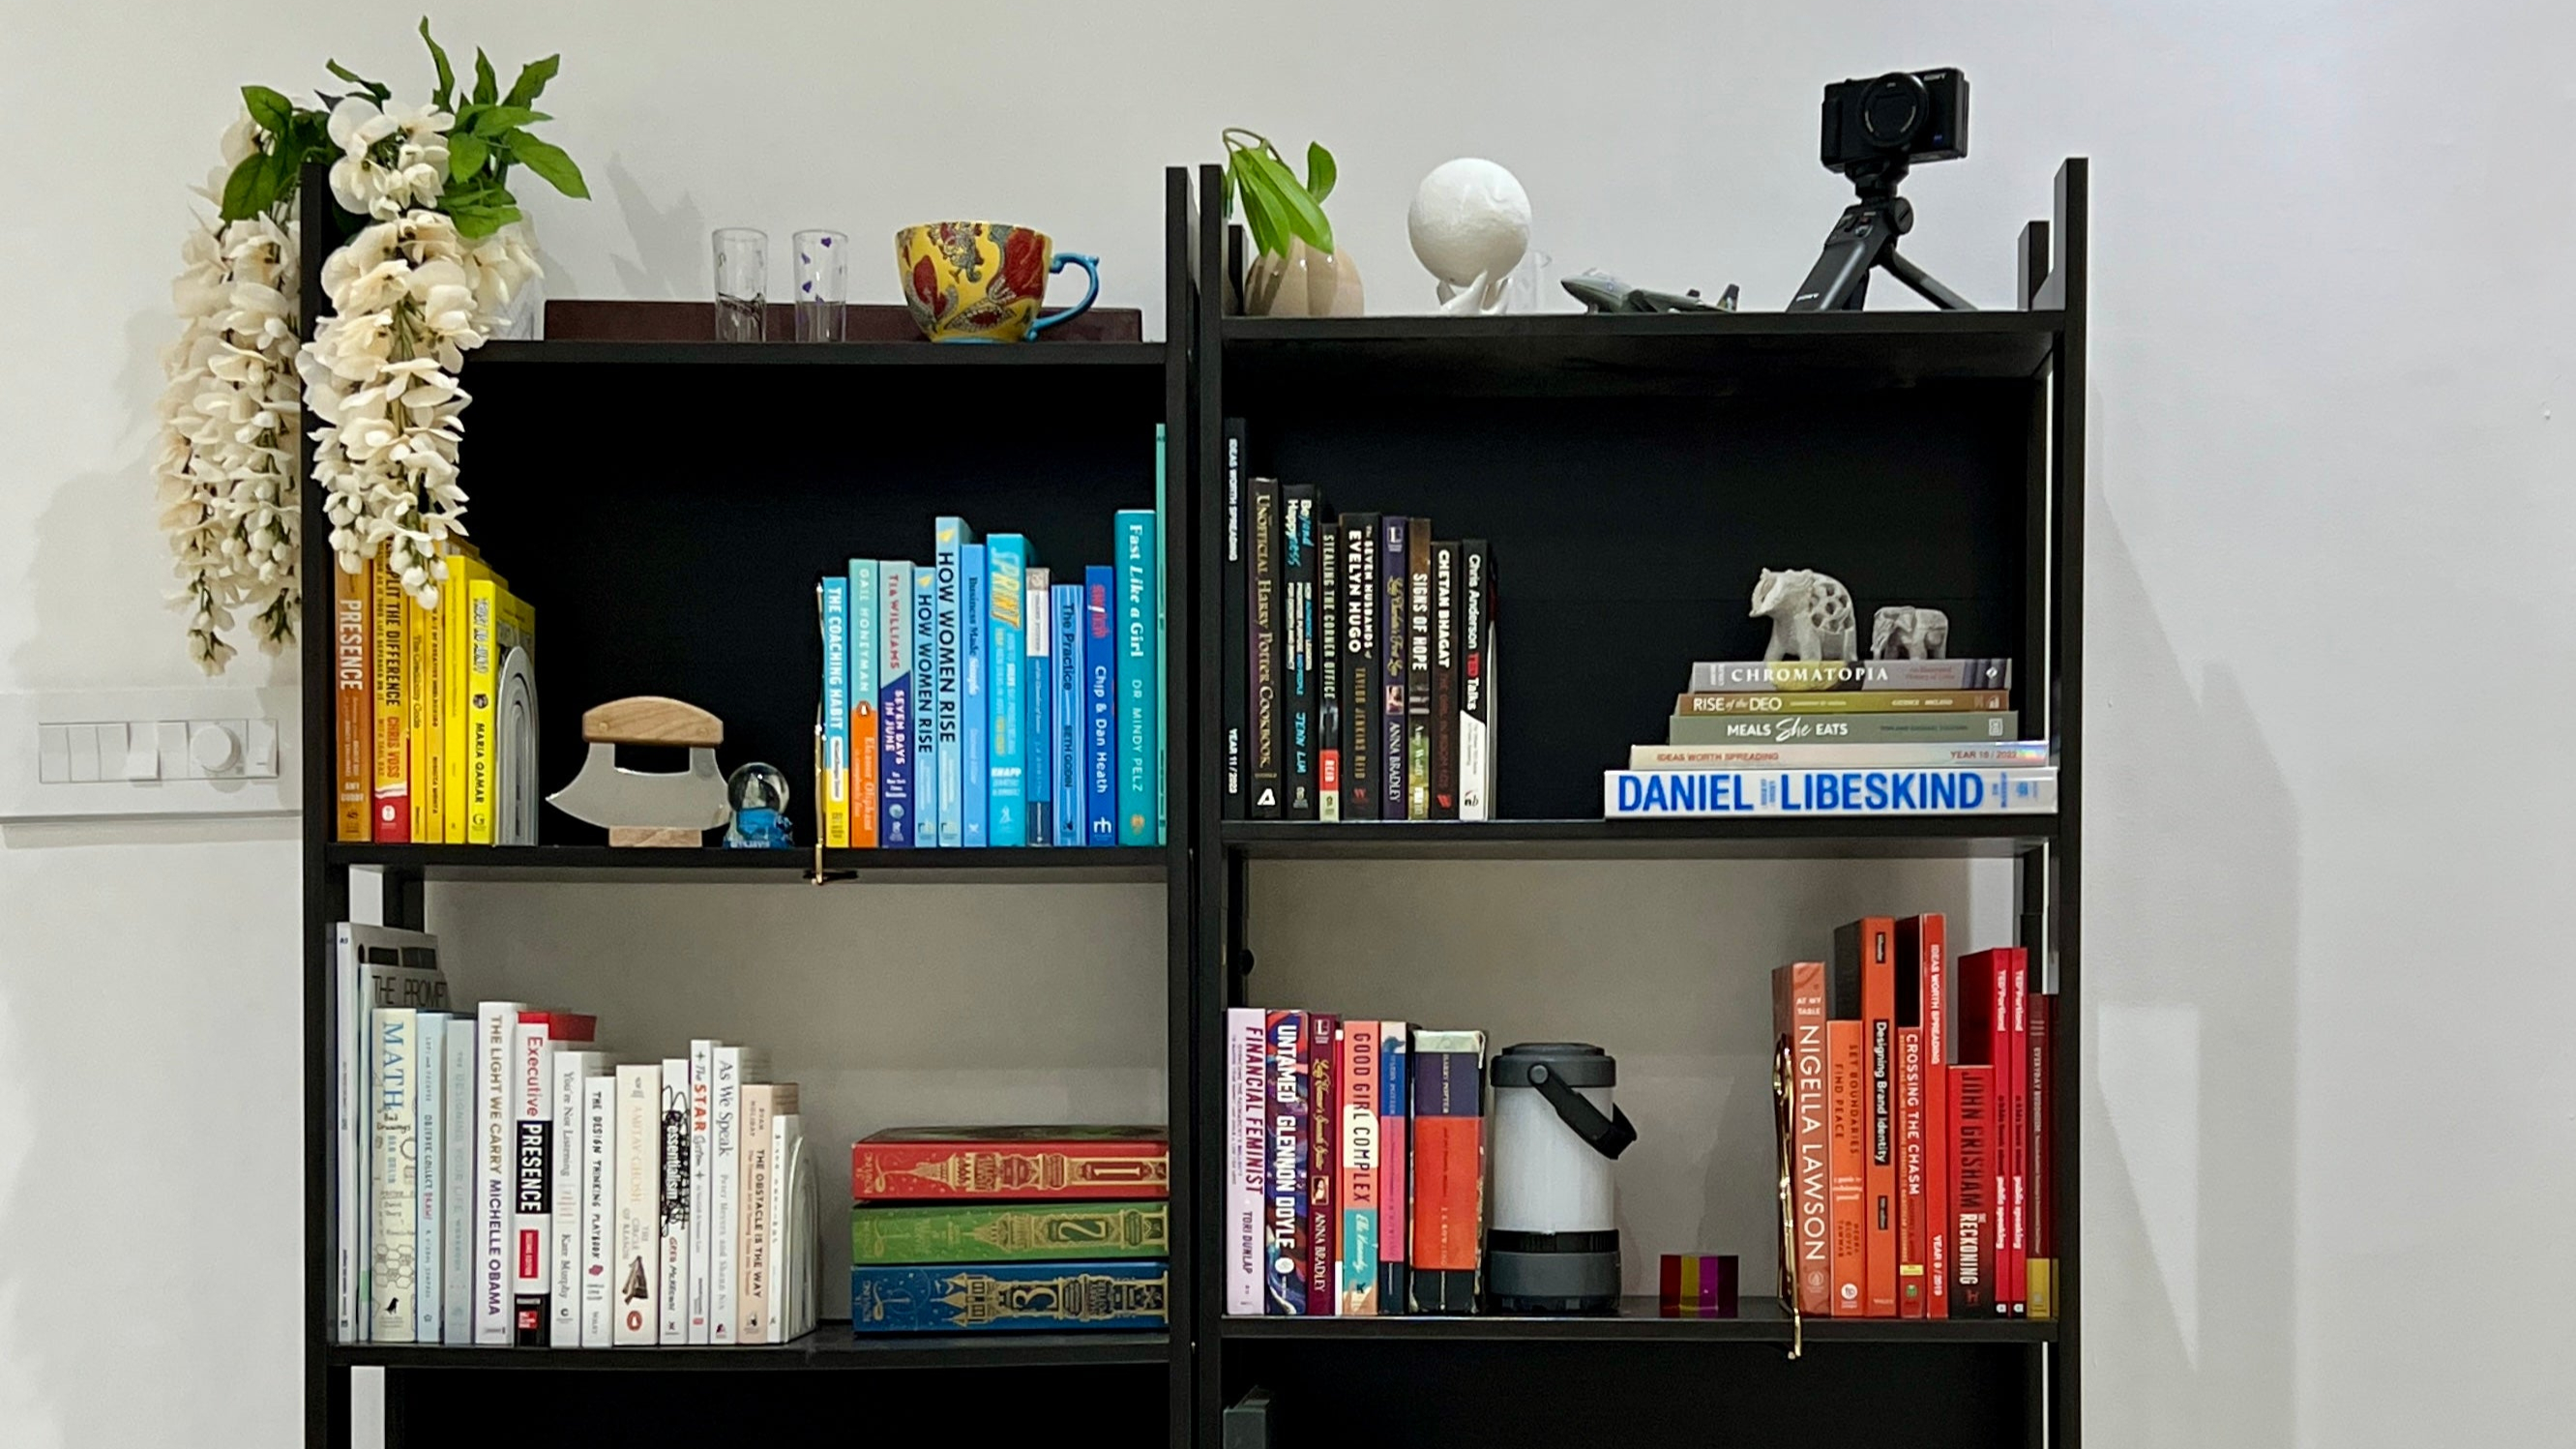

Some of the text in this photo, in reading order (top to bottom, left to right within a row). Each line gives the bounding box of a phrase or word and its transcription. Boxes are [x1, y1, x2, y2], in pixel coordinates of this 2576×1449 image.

[1229, 438, 1238, 561] IDEAS WORTH SPREADING
[938, 552, 955, 604] HOW
[991, 547, 1022, 630] SPRINT
[1130, 524, 1143, 657] Fast Like a Girl
[1349, 530, 1361, 653] EVELYN HUGO
[1364, 541, 1373, 579] SEVEN
[1467, 554, 1480, 587] Chris
[387, 604, 400, 626] THE
[829, 587, 843, 613] THE
[859, 568, 870, 692] GAIL HONEYMAN
[889, 575, 900, 669] TIA WILLIAMS
[918, 594, 933, 636] HOW
[1323, 534, 1335, 698] STEALING THE CORNER OFFICE
[1364, 584, 1373, 648] HUSBANDS
[1412, 573, 1427, 670] SIGNS OF HOPE
[1438, 550, 1450, 667] CHETAN BHAGAT
[1467, 590, 1480, 649] Anderson
[340, 600, 363, 690] PRESENCE
[387, 631, 400, 706] DIFFERENCE
[413, 636, 422, 651] The
[829, 616, 843, 685] COACHING
[918, 643, 933, 714] WOMEN
[938, 611, 955, 693] WOMEN
[1063, 603, 1074, 691] The Practice
[1732, 667, 1888, 682] CHROMATOPIA
[413, 703, 422, 727] Code
[831, 689, 843, 729] HABIT
[885, 702, 894, 752] IN JUNE
[895, 690, 905, 729] SEVEN
[938, 701, 955, 742] RISE
[1094, 665, 1108, 792] Chip & Dan Heath
[1132, 707, 1142, 752] MINDY
[1467, 678, 1479, 710] Talks
[1694, 697, 1725, 711] RISE
[1749, 697, 1782, 711] DEO
[1728, 717, 1849, 742] MEALS She EATS
[387, 717, 400, 778] CHRIS VOSS
[475, 723, 485, 803] MARIA QAMAR
[895, 733, 905, 765] DAYS
[918, 719, 933, 753] RISE
[1389, 722, 1400, 802] ANNA BRADLEY
[1688, 753, 1722, 761] WORTH
[863, 737, 874, 831] Eleanor Oliphant
[1132, 757, 1142, 792] PELZ
[1618, 775, 1754, 811] DANIEL
[1781, 772, 1984, 811] LIBESKIND
[1931, 944, 1939, 1064] IDEAS WORTH SPREADING
[383, 1021, 404, 1109] MATH
[527, 1036, 543, 1116] Executive
[695, 1065, 706, 1080] The
[1849, 1045, 1859, 1066] SET
[1875, 1021, 1888, 1162] Designing Brand Identity
[1907, 1034, 1919, 1107] CROSSING
[490, 1015, 502, 1174] THE LIGHT WE CARRY
[561, 1071, 575, 1175] You're Not Listening
[695, 1084, 706, 1132] STAR
[716, 1061, 733, 1156] As We Speak
[1246, 1027, 1263, 1195] FINANCIAL FEMINIST
[1353, 1032, 1371, 1202] GOOD GIRL COMPLEX
[1835, 1064, 1844, 1138] FIND PEACE
[1907, 1111, 1919, 1138] THE
[521, 1123, 542, 1211] PRESENCE
[667, 1125, 681, 1199] essentialism
[1094, 1168, 1140, 1176] 1
[1276, 1025, 1297, 1249] UNTAMED GLENNON DOYLE
[1799, 1025, 1825, 1259] NIGELLA LAWSON
[1907, 1144, 1919, 1195] CHASM
[1961, 1072, 1984, 1207] JOHN GRISHAM
[592, 1091, 602, 1257] THE DESIGN THINKING PLAYBOOK
[489, 1179, 501, 1316] MICHELLE OBAMA
[755, 1149, 764, 1298] THE OBSTACLE IS THE WAY
[1058, 1221, 1107, 1241] 2
[1242, 1211, 1253, 1274] TORI DUNLAP
[1315, 1211, 1325, 1291] ANNA BRADLEY
[1960, 1213, 1978, 1285] RECKONING
[559, 1233, 571, 1298] Kate Murphy
[1015, 1286, 1058, 1310] 3
